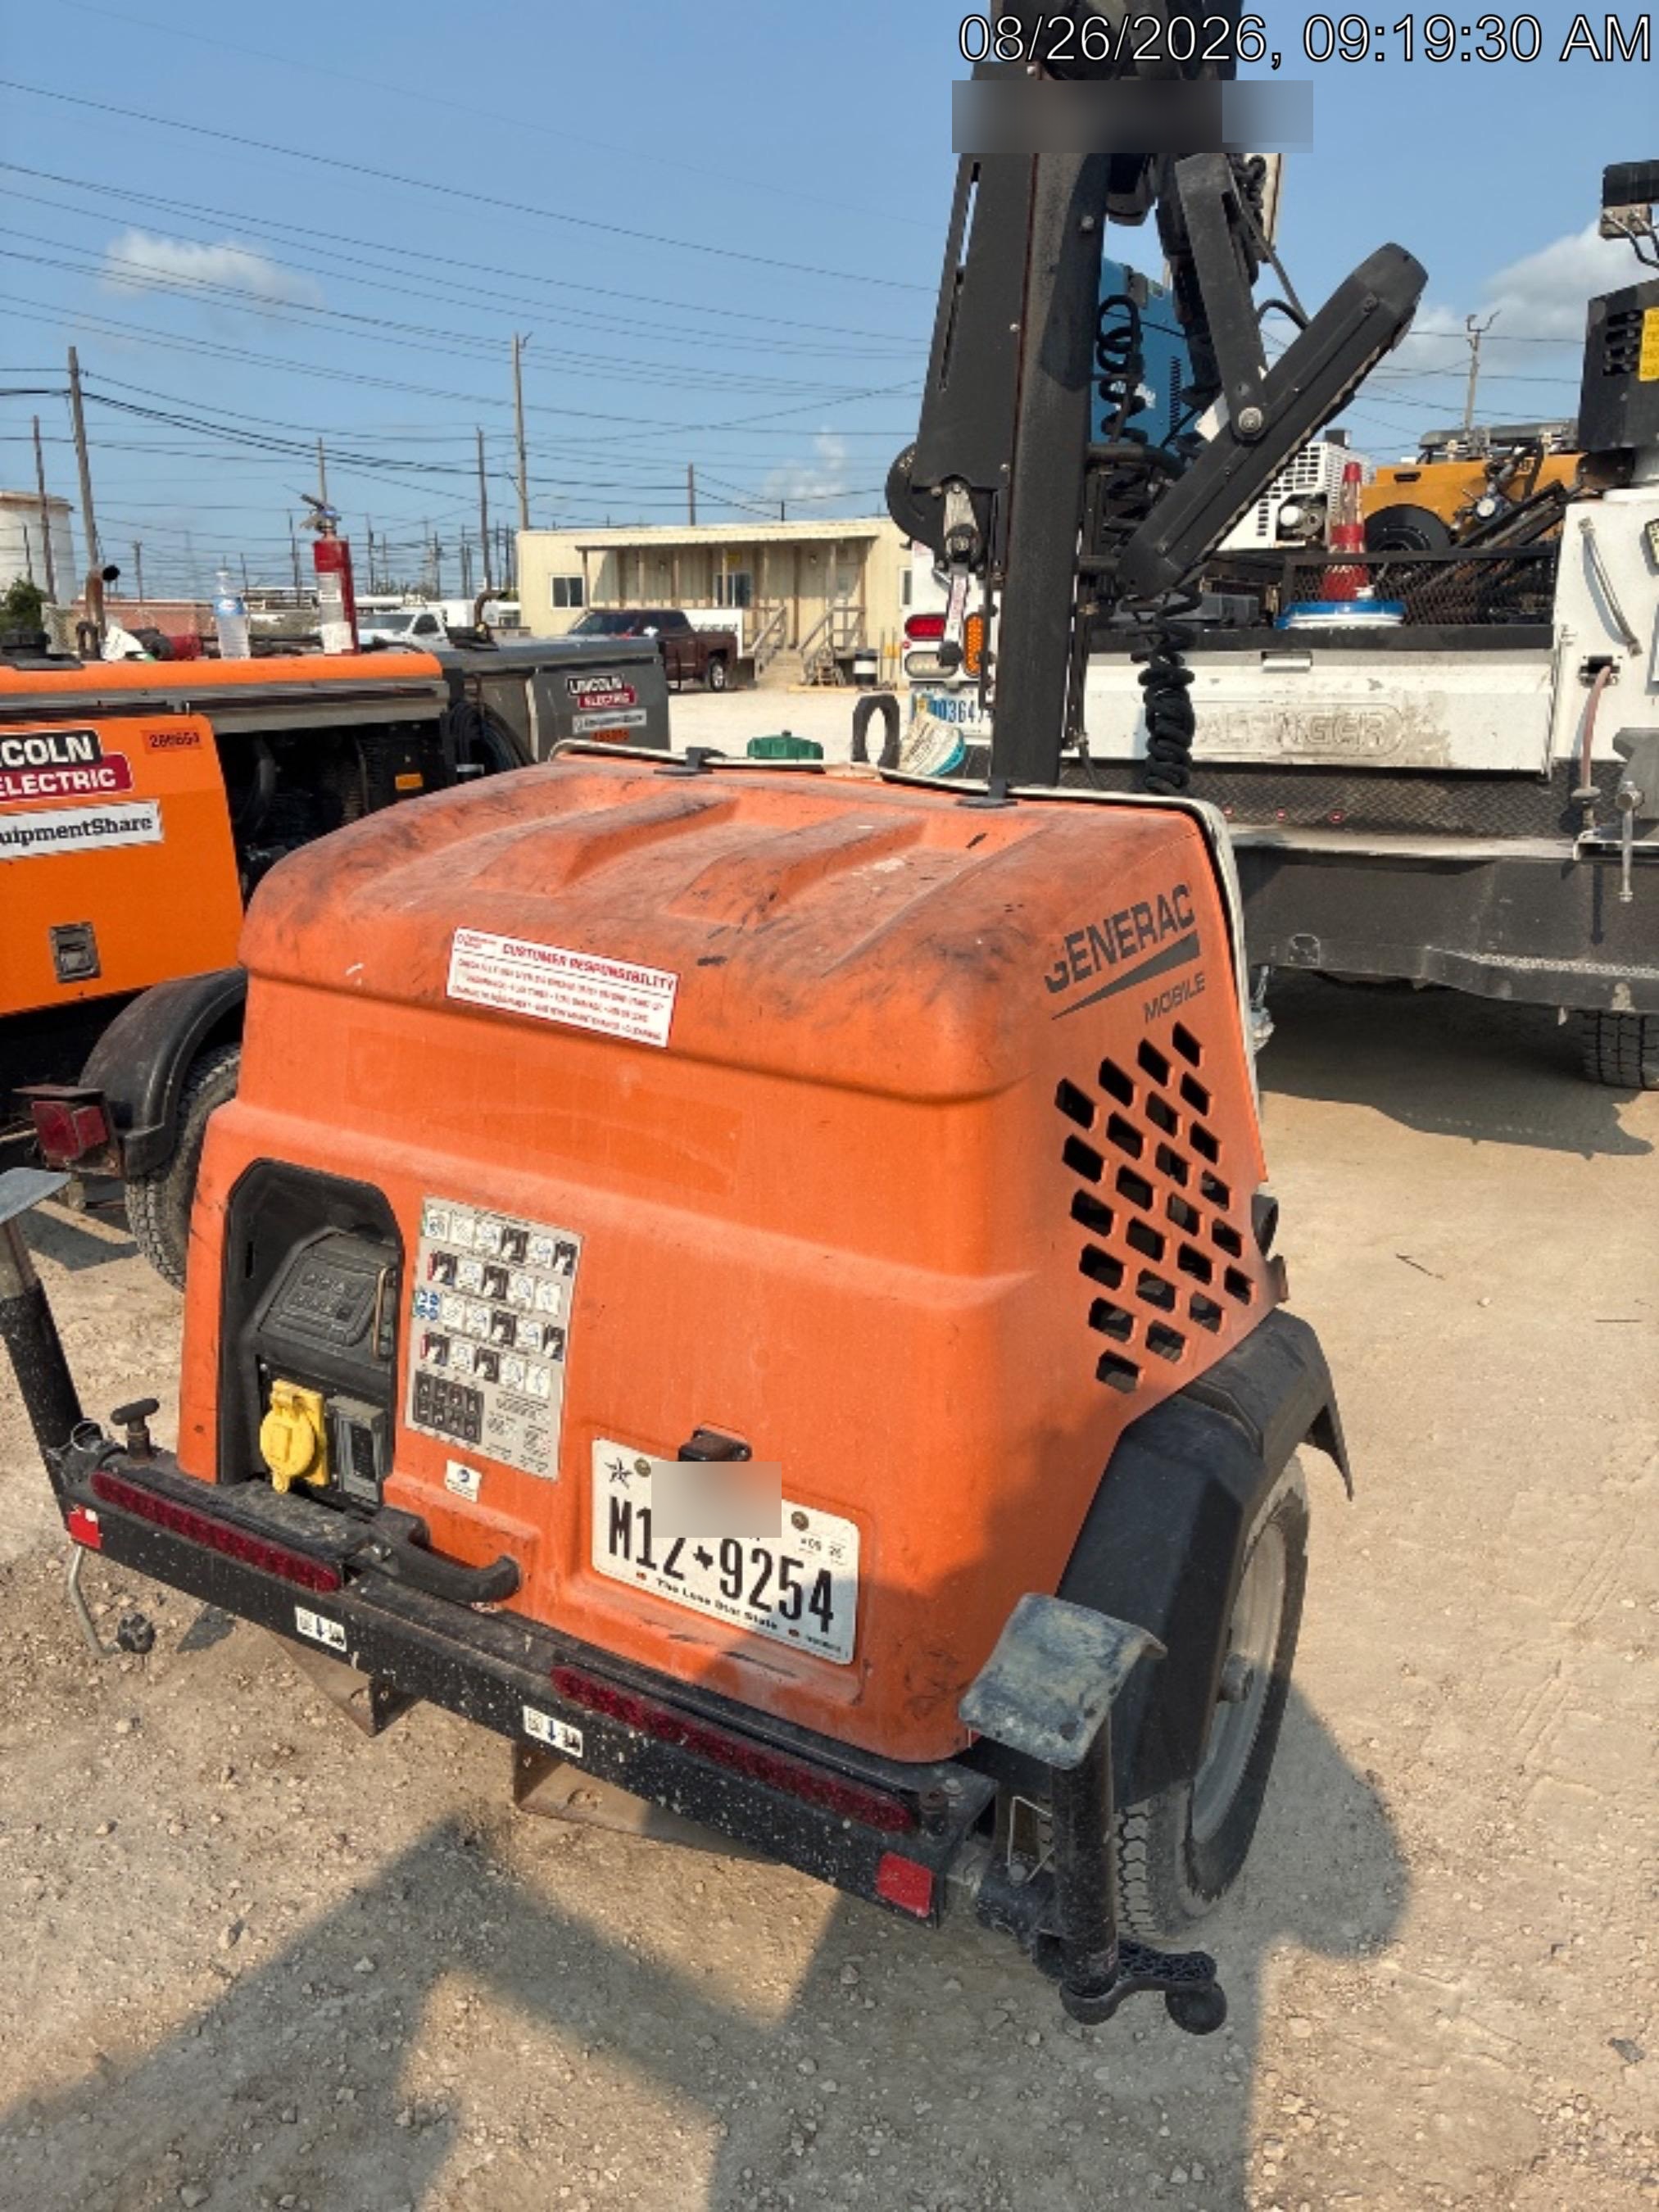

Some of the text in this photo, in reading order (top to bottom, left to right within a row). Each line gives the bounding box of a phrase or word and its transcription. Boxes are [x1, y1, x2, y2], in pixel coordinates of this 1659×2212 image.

[0, 734, 94, 768] COLN
[0, 817, 153, 846] uipmentShare
[502, 943, 566, 968] CUSTOMER
[569, 958, 674, 990] RESPONSIBILITY
[1144, 971, 1206, 1023] MOBILE
[656, 1578, 679, 1593] The
[682, 1587, 711, 1606] Lone
[744, 1611, 777, 1630] State
[719, 1538, 834, 1633] 9254
